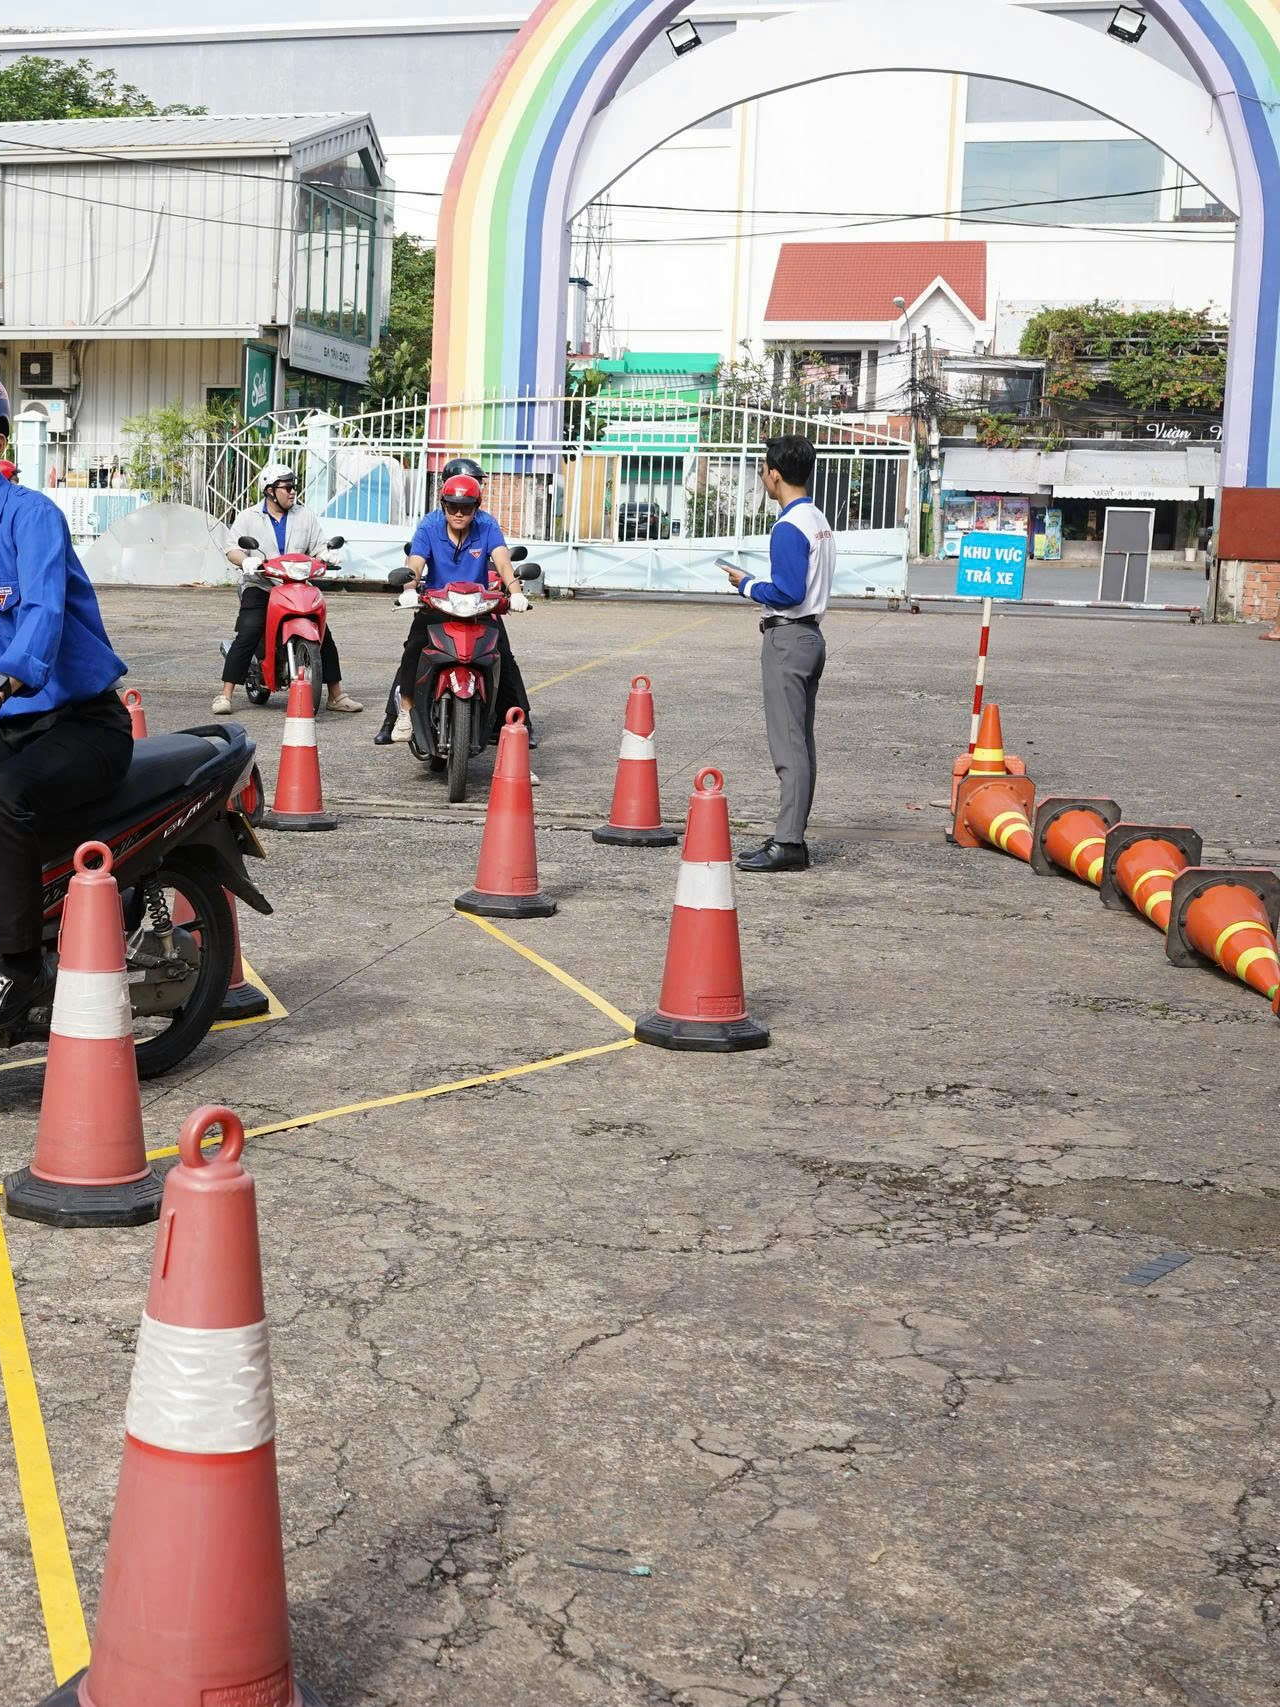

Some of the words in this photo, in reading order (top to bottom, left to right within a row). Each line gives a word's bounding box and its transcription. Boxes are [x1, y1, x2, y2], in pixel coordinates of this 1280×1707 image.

[963, 545, 992, 560] KHU
[995, 547, 1023, 564] VỰC
[965, 566, 992, 584] TRẢ
[995, 571, 1015, 586] XE
